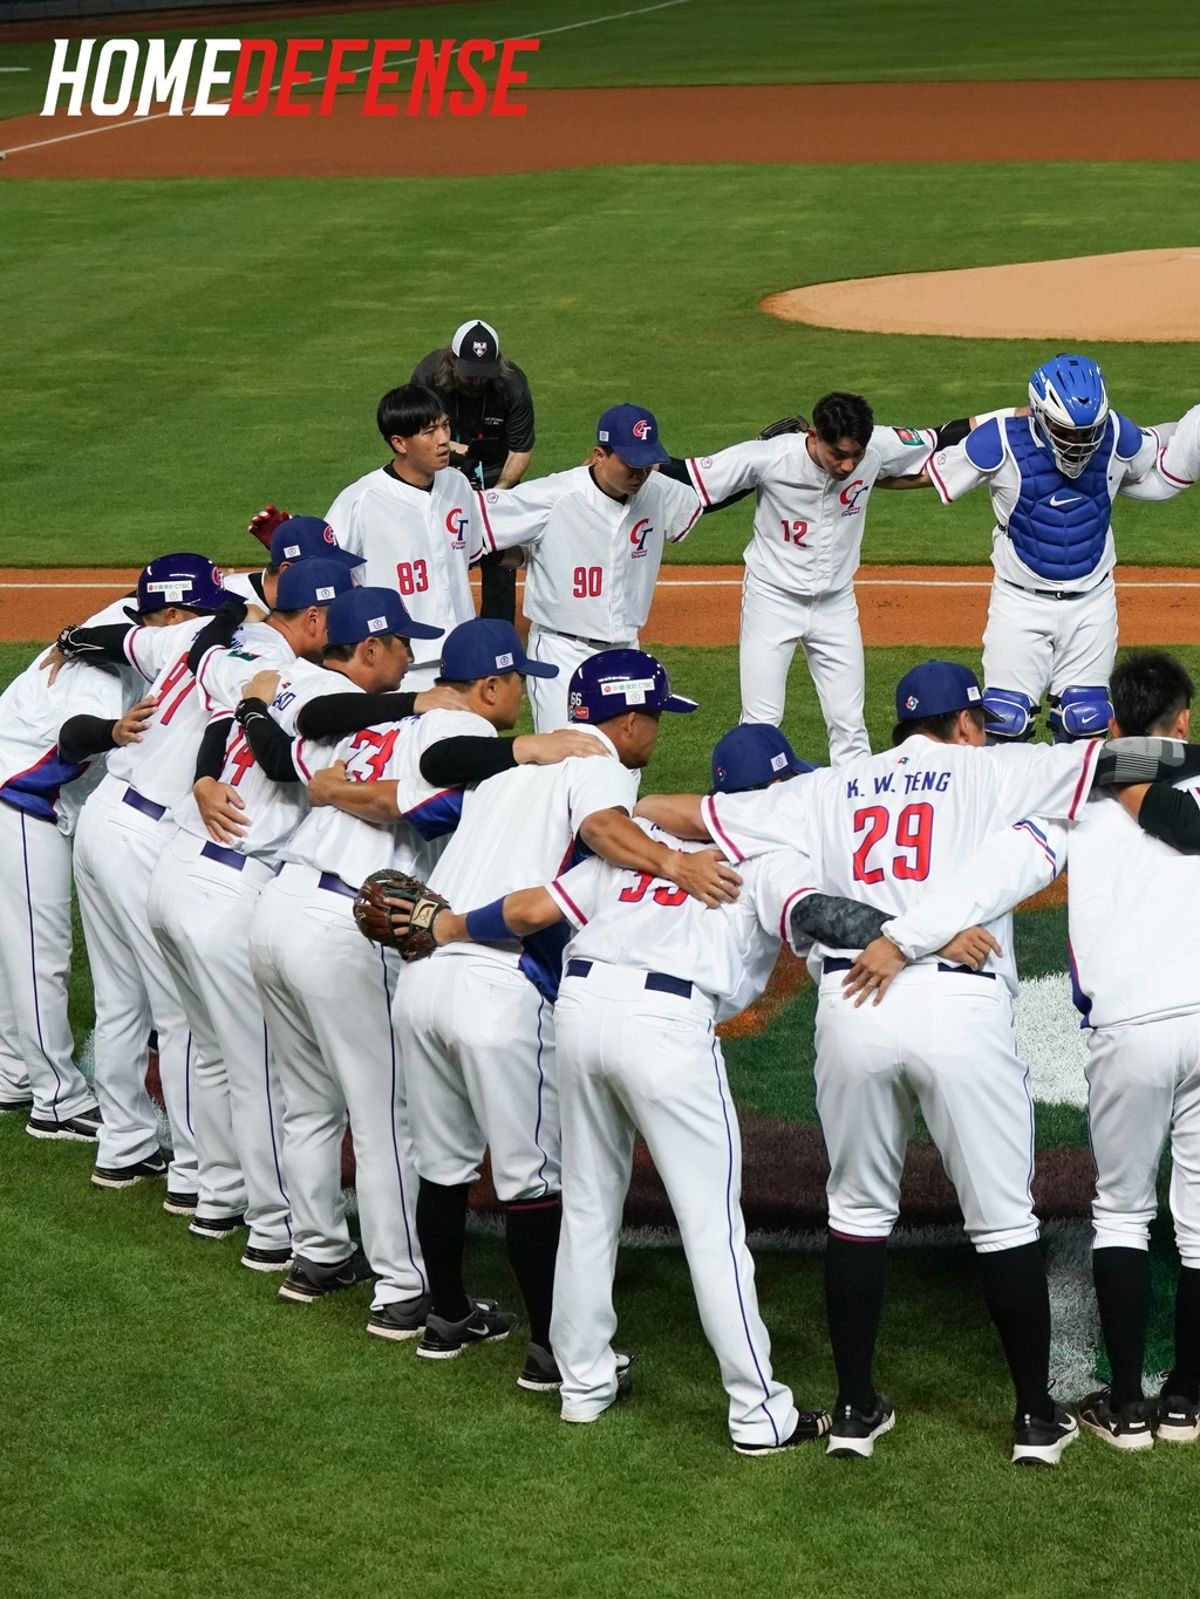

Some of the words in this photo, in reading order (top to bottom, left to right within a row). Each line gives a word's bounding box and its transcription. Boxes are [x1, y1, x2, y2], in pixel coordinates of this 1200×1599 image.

[781, 519, 808, 548] 12
[396, 559, 429, 596] 83
[573, 566, 603, 598] 90
[853, 802, 934, 885] 29
